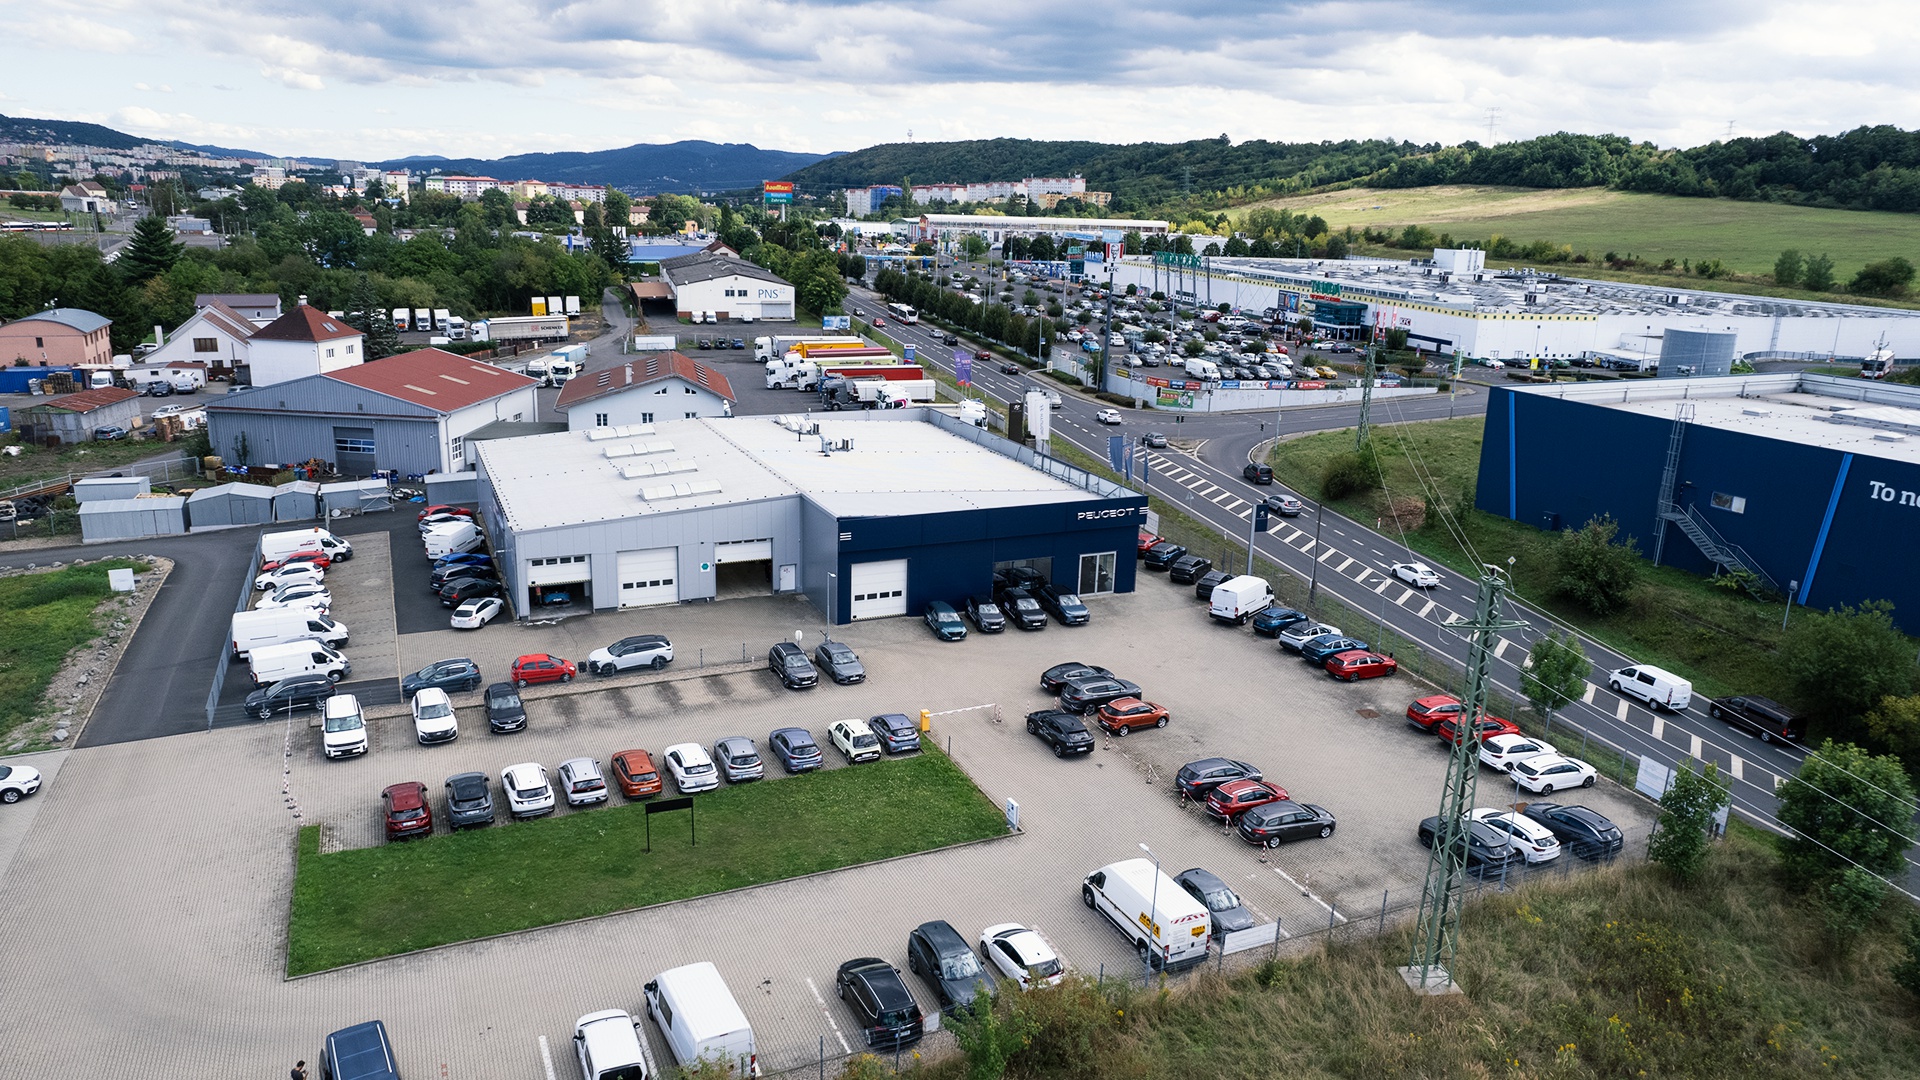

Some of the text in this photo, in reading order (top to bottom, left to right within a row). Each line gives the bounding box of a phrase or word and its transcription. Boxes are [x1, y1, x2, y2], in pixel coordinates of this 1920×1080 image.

[758, 289, 779, 299] PNS
[1869, 480, 1896, 502] To
[1077, 507, 1135, 520] PEUGEOT
